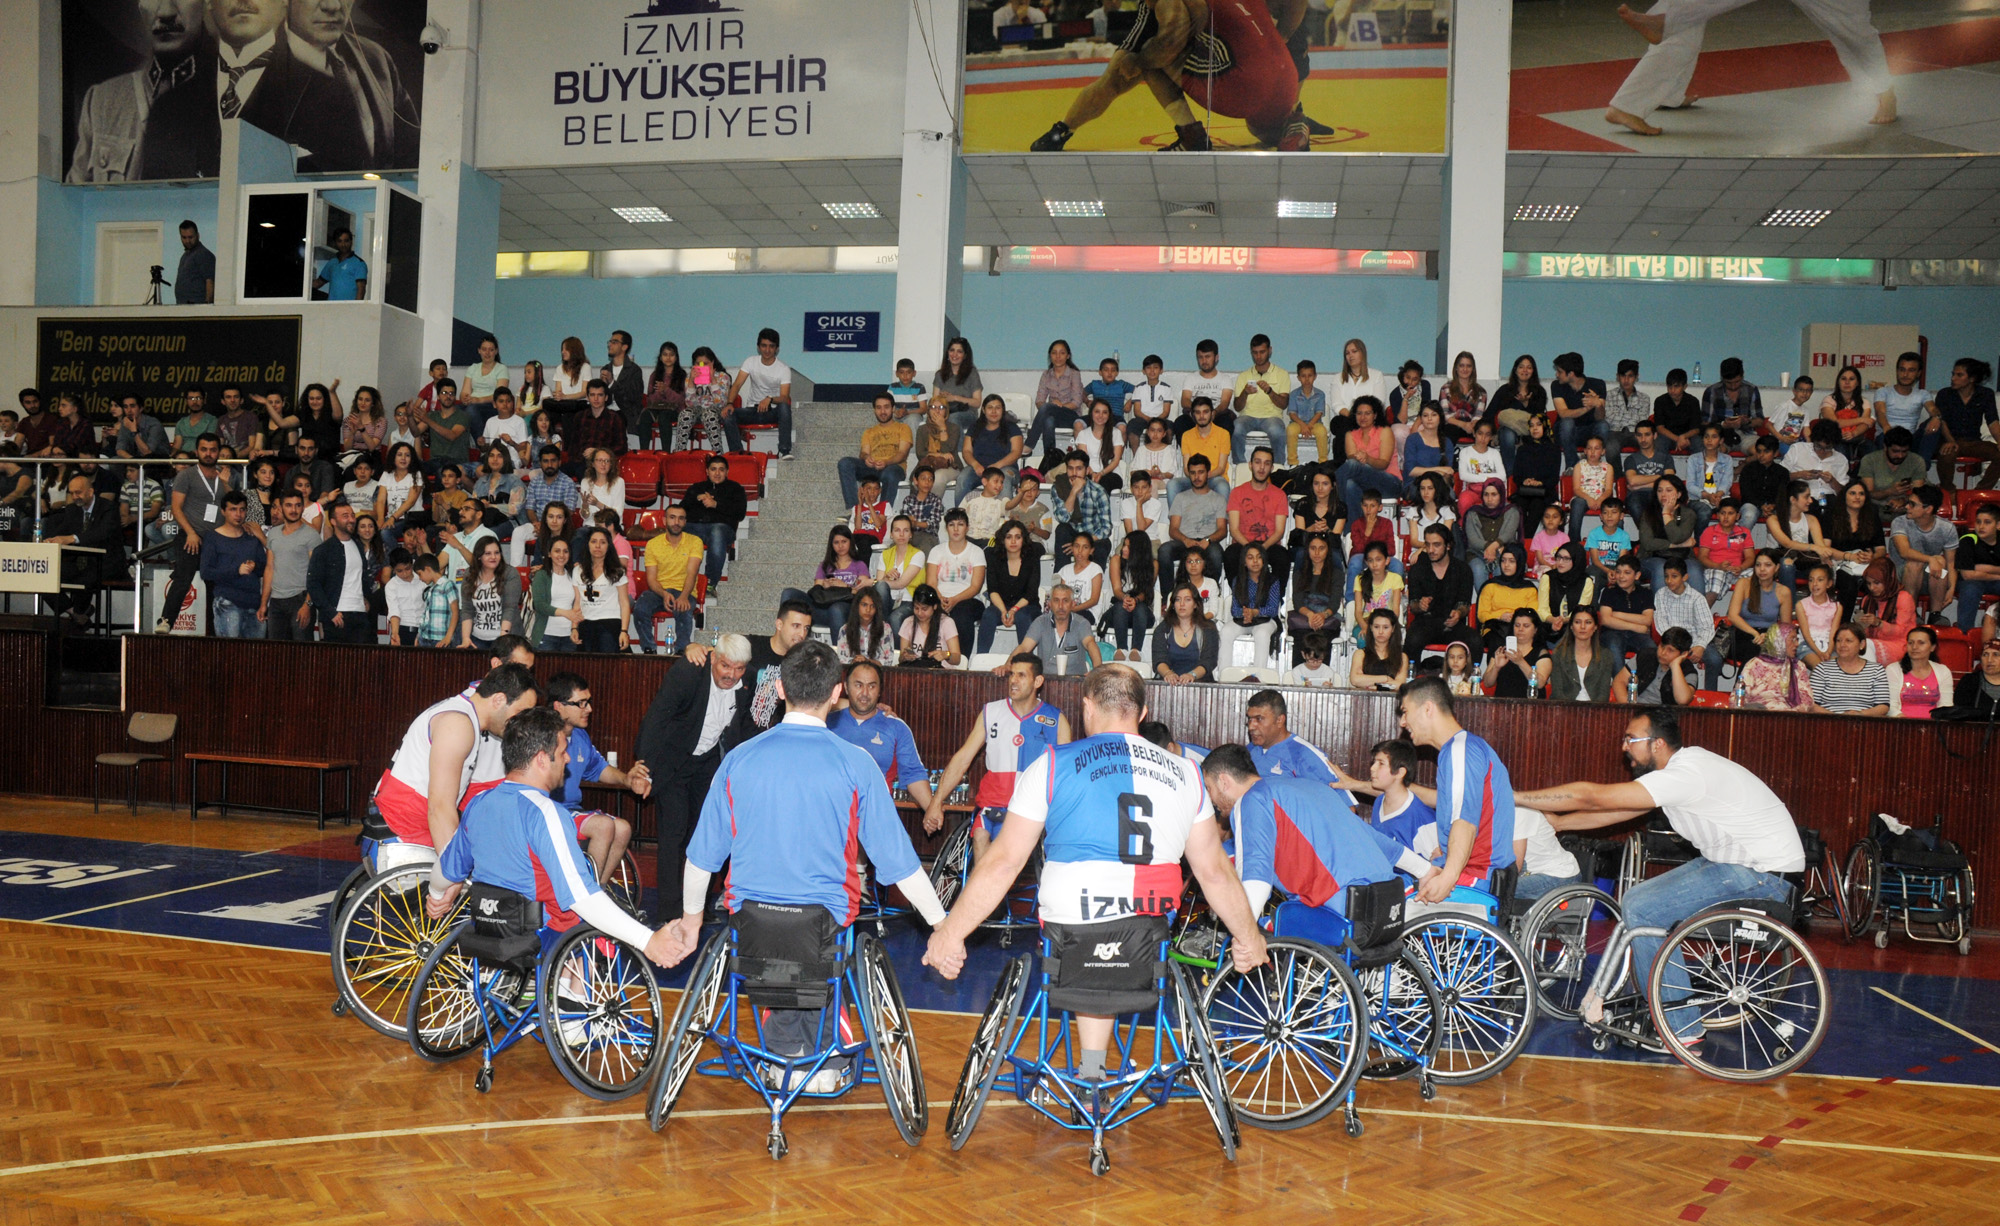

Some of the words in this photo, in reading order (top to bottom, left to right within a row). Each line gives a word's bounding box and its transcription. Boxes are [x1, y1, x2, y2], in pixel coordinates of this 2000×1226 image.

[622, 17, 744, 56] İZMİR
[553, 53, 827, 105] BÜYÜKŞEHİR
[563, 101, 813, 146] BELEDİYESİ
[818, 316, 866, 329] ÇIKIŞ
[56, 330, 92, 352] "Ben
[99, 335, 186, 357] sporcunun
[828, 333, 854, 341] EXIT
[51, 361, 86, 385] zeki,
[92, 361, 135, 387] çevik
[142, 367, 161, 382] ve
[166, 366, 200, 388] aynı
[204, 366, 259, 383] zaman
[264, 361, 286, 382] da
[2, 556, 49, 574] BELEDİYESİ
[1074, 740, 1132, 774] BÜYÜKŞEHİR
[1132, 744, 1187, 785] BELEDİYESİ
[1090, 762, 1119, 782] GENÇLİK
[1120, 764, 1129, 774] VE
[1129, 766, 1148, 777] SPOR
[1149, 769, 1177, 791] KULÜBÜ
[1117, 792, 1154, 865] 6
[479, 897, 499, 916] RGK
[757, 902, 803, 914] INTERCEPTOR
[1093, 941, 1122, 961] RGK
